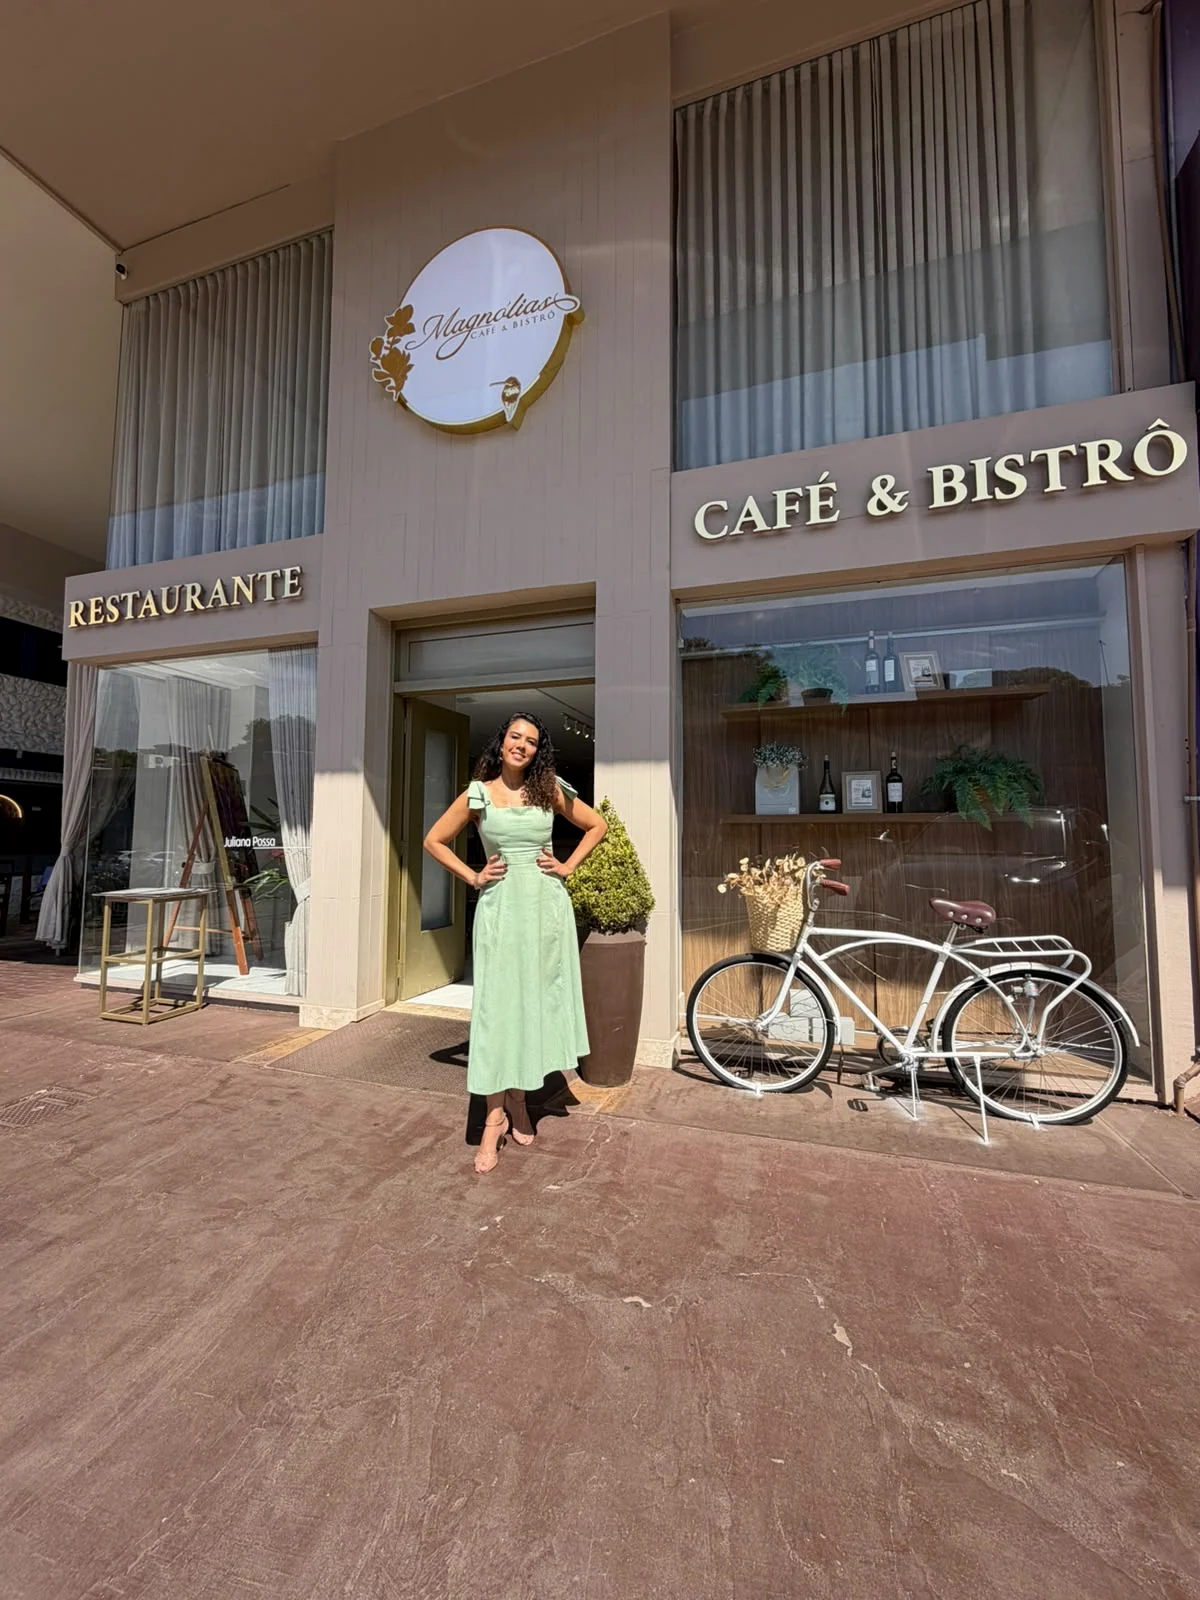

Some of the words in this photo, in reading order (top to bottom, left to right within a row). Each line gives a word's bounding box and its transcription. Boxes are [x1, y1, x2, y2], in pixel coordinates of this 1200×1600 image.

[404, 292, 579, 361] Magnólias
[470, 323, 497, 340] CAFÉ
[693, 470, 841, 541] CAFÉ
[866, 473, 909, 518] &
[927, 417, 1189, 510] BISTRÔ
[68, 565, 304, 629] RESTAURANTE
[223, 835, 251, 848] Juliana
[252, 836, 276, 847] Possa
